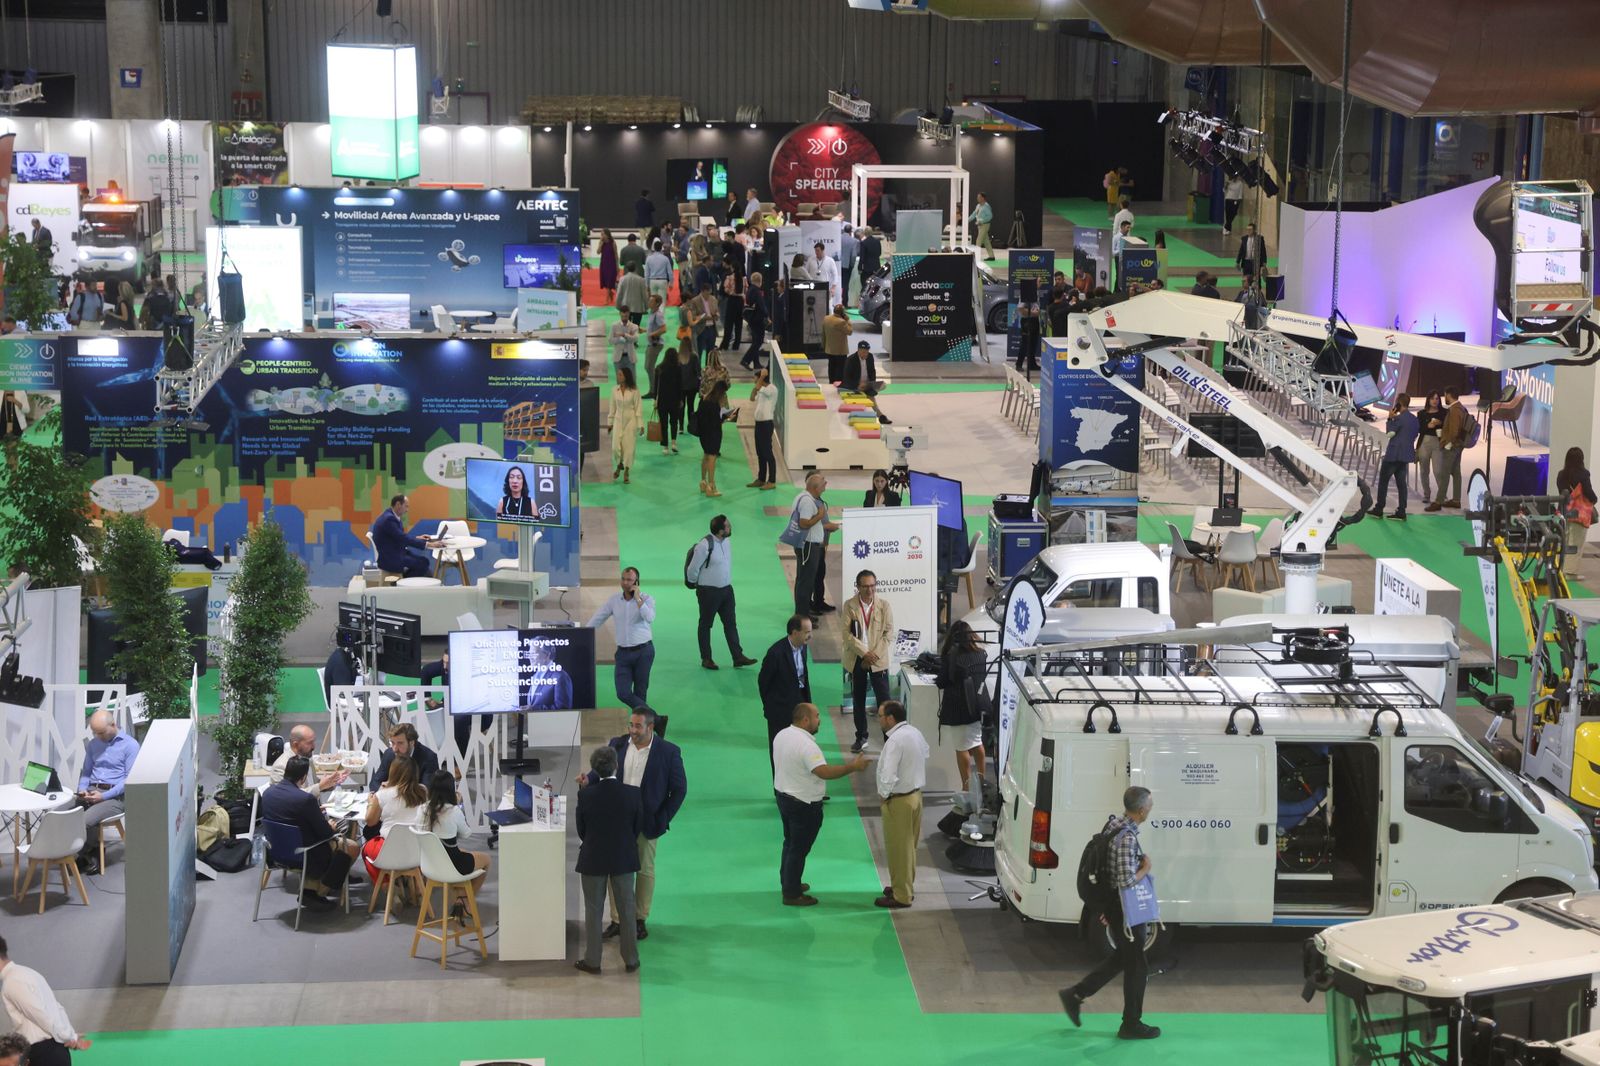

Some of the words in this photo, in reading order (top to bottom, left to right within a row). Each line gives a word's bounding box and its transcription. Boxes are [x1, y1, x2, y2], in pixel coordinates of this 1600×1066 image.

[228, 154, 250, 163] puerta
[814, 168, 839, 178] CITY
[516, 200, 568, 210] AERTEC
[334, 211, 378, 220] Movilidad
[381, 211, 408, 220] Aérea
[410, 212, 454, 220] Avanzada
[464, 212, 500, 222] U-space
[910, 281, 954, 289] activacar
[564, 352, 576, 360] 23
[1384, 568, 1404, 598] ÚNETE
[1405, 586, 1410, 602] A
[1412, 590, 1420, 608] LA
[510, 638, 522, 648] de
[524, 638, 570, 648] Proyectos
[480, 664, 548, 674] Observatorio
[549, 662, 562, 672] de
[488, 676, 558, 687] Subvenciones
[1162, 820, 1182, 828] 900
[1186, 820, 1206, 828] 460
[1210, 820, 1231, 828] 060
